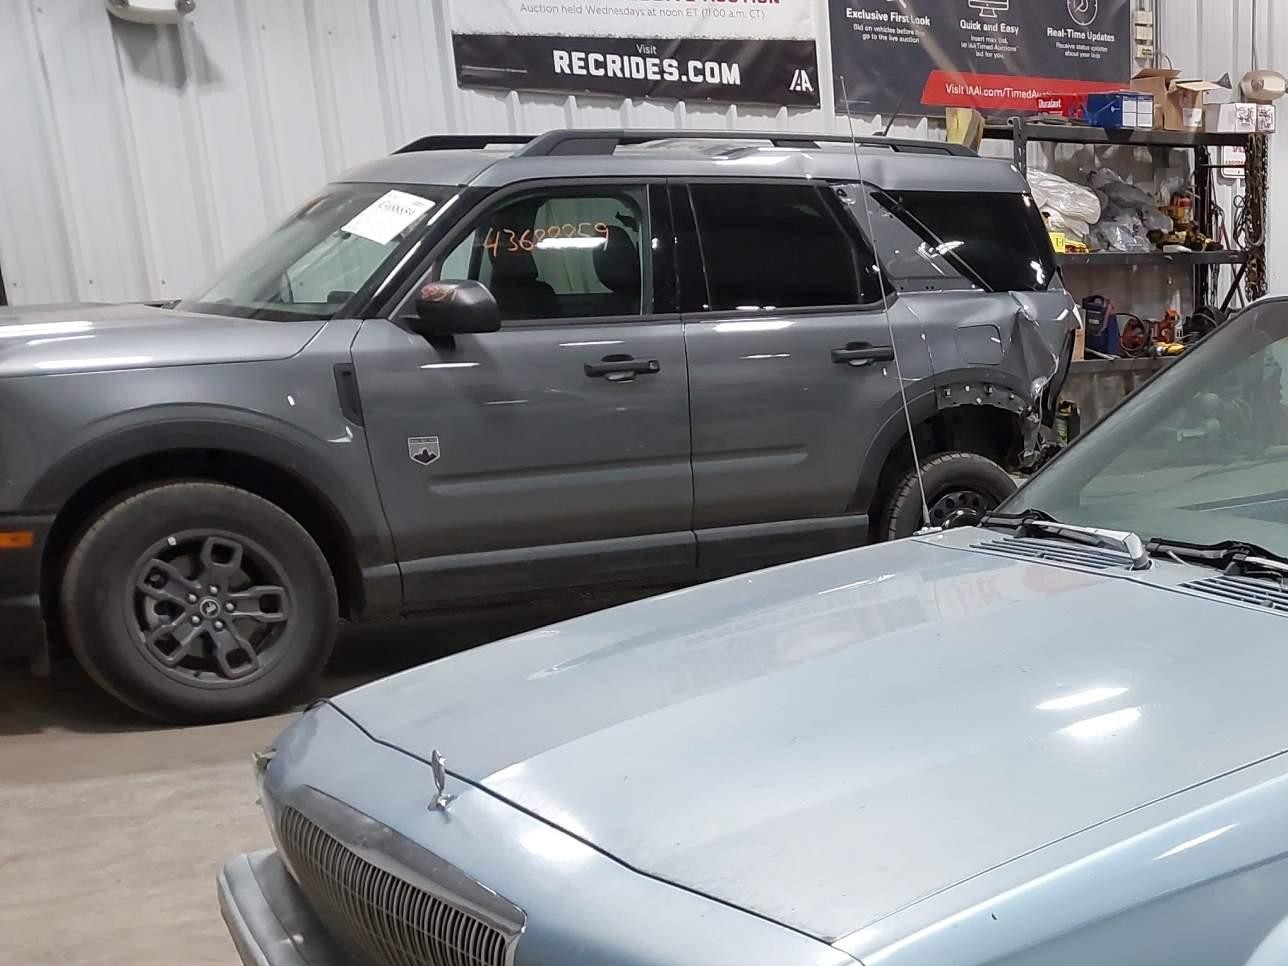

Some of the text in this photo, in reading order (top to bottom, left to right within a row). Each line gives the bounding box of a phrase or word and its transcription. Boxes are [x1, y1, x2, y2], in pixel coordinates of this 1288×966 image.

[520, 3, 559, 14] Auction
[561, 4, 583, 15] held
[586, 5, 645, 17] Wednesdays
[648, 7, 657, 17] at
[659, 8, 684, 17] noon
[686, 8, 698, 17] ET
[846, 7, 931, 27] Exclusive First Look
[865, 25, 873, 33] on
[874, 25, 896, 35] vehicles
[960, 18, 1020, 36] Quick and Easy
[871, 33, 878, 41] to
[878, 34, 888, 42] the
[1046, 26, 1116, 43] Real-Time Updates
[637, 44, 658, 56] Visit
[552, 50, 742, 86] RECRIDES.COM
[945, 82, 965, 95] Visit
